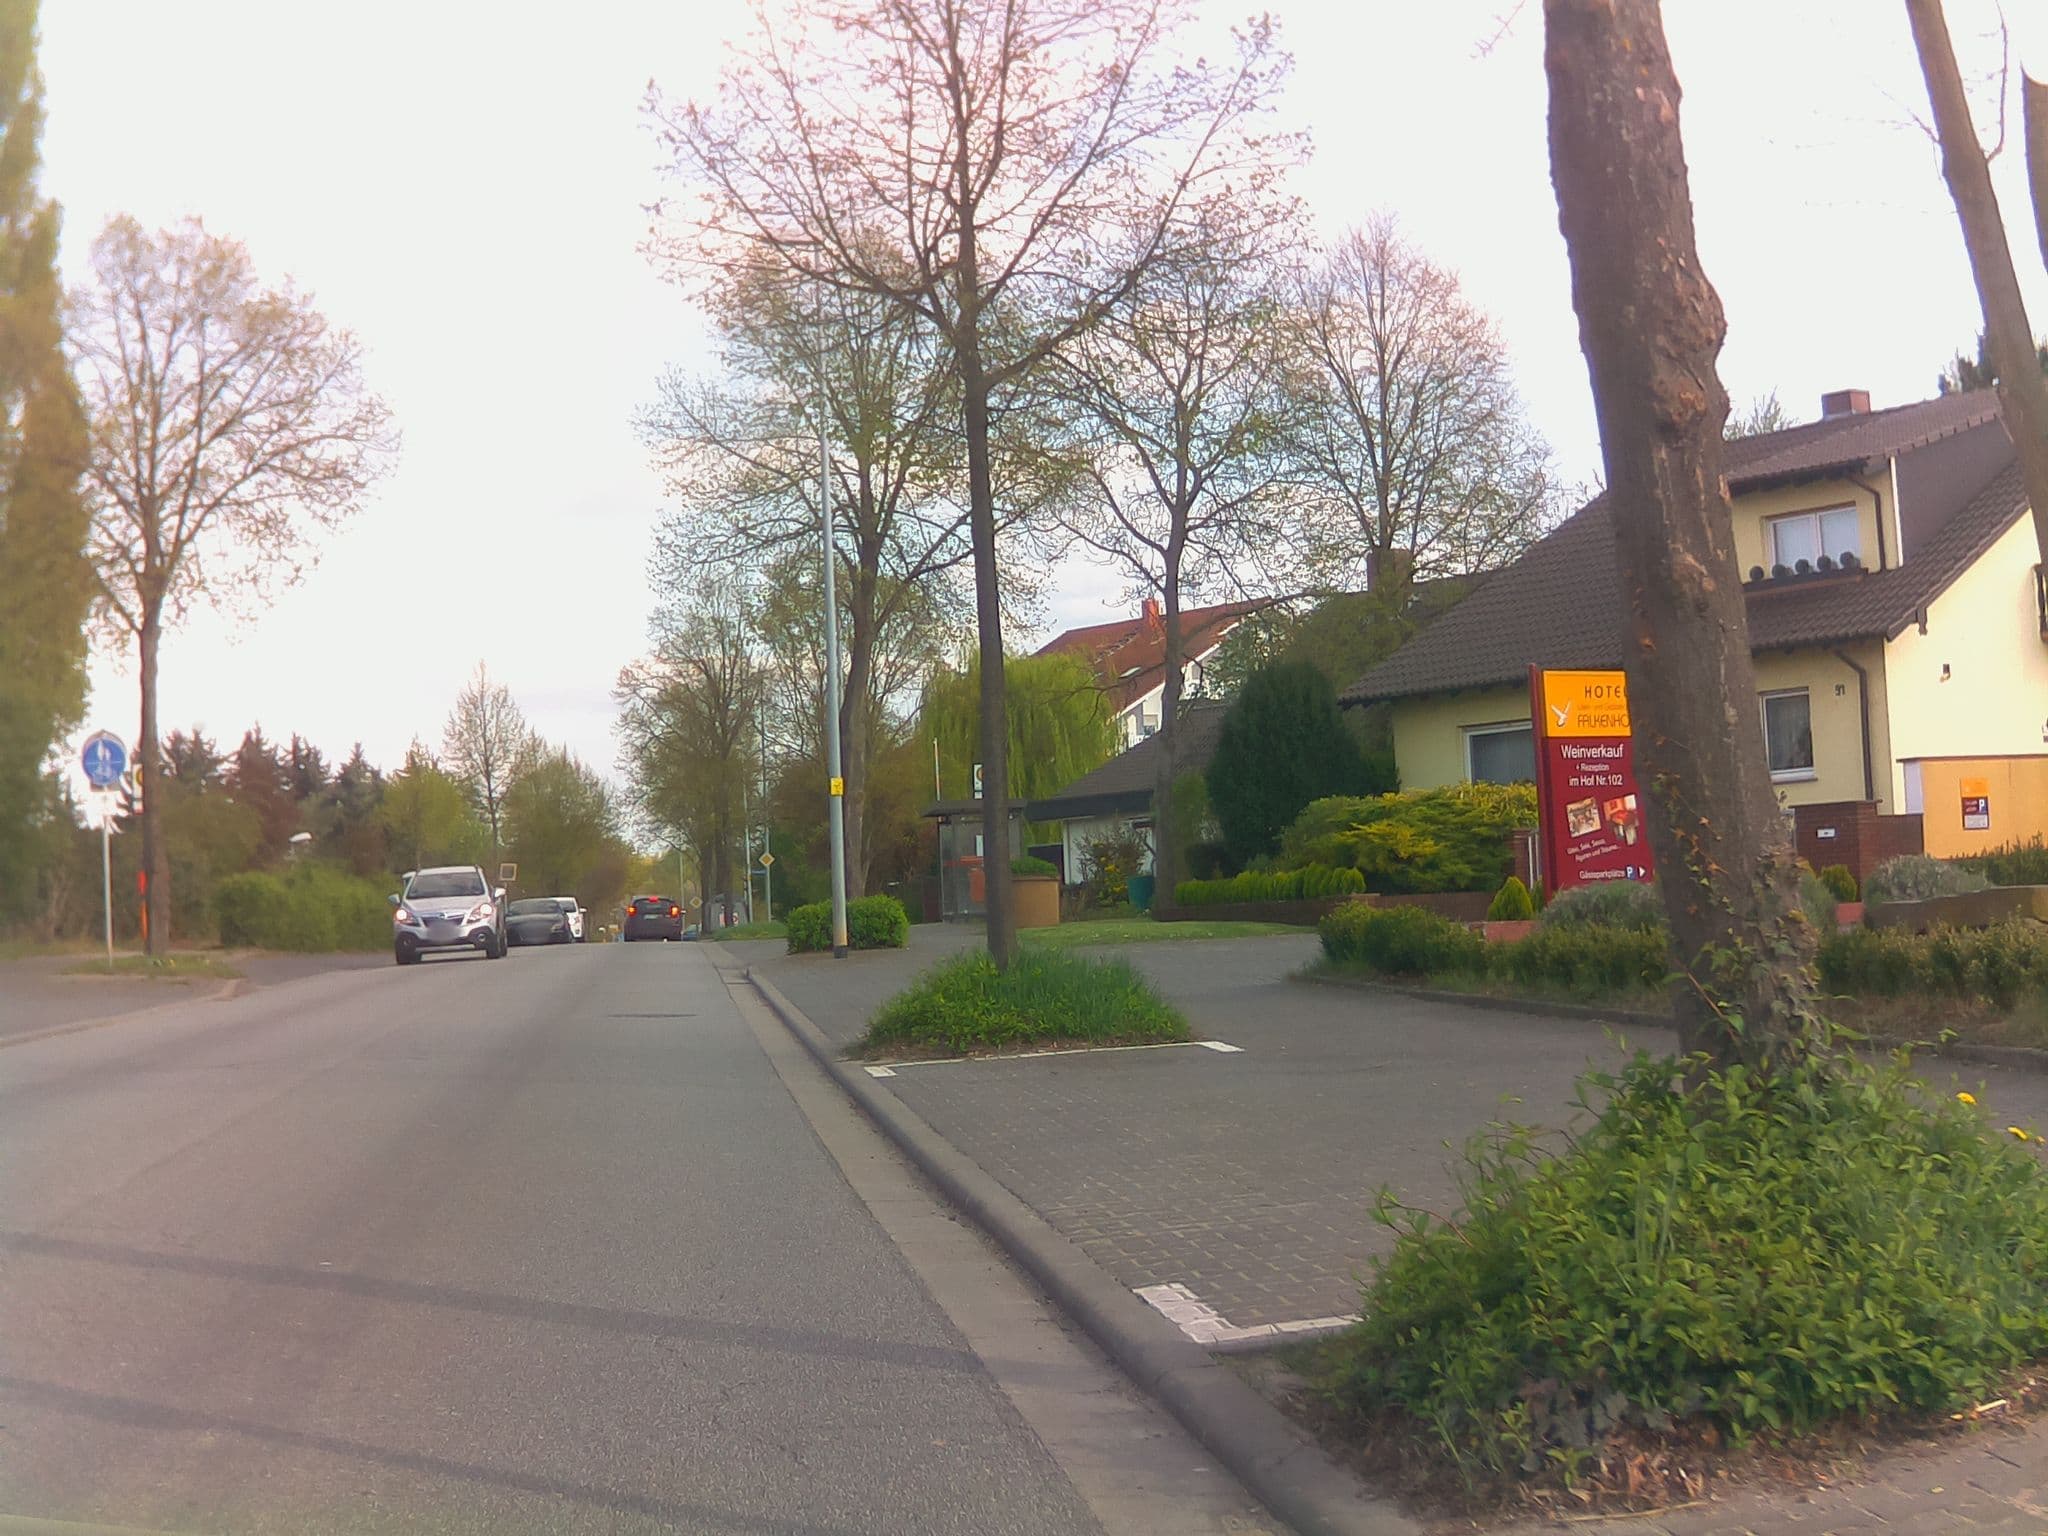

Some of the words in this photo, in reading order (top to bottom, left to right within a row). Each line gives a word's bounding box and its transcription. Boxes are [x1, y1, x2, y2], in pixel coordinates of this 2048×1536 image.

[1577, 714, 1631, 728] FALKENHO
[1561, 743, 1624, 758] Weinverkauf
[1569, 775, 1579, 787] im
[1580, 774, 1594, 786] Hof
